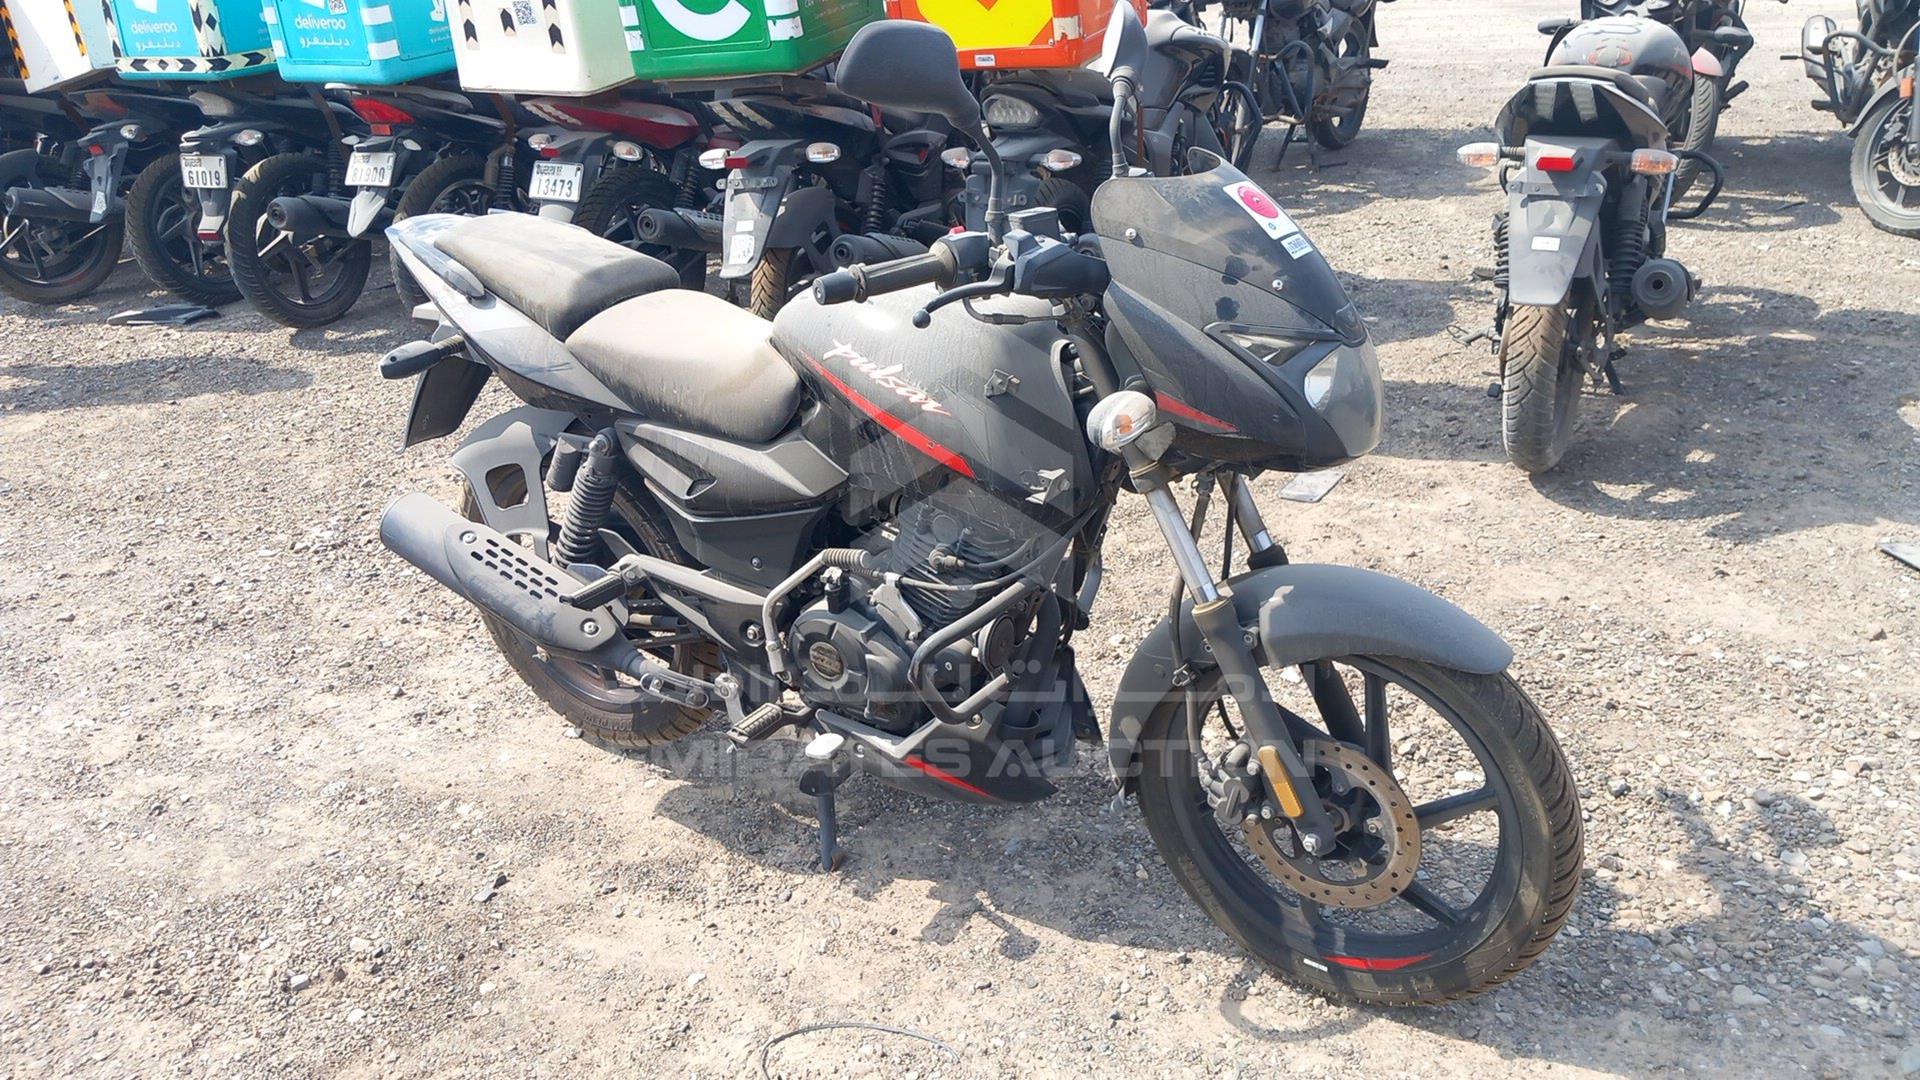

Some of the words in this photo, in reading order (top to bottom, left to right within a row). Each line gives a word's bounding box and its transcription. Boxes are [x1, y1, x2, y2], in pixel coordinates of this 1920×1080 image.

[130, 20, 178, 34] deliveroo
[295, 14, 347, 31] deliveroo
[187, 170, 221, 186] 61019
[536, 178, 573, 198] 13473
